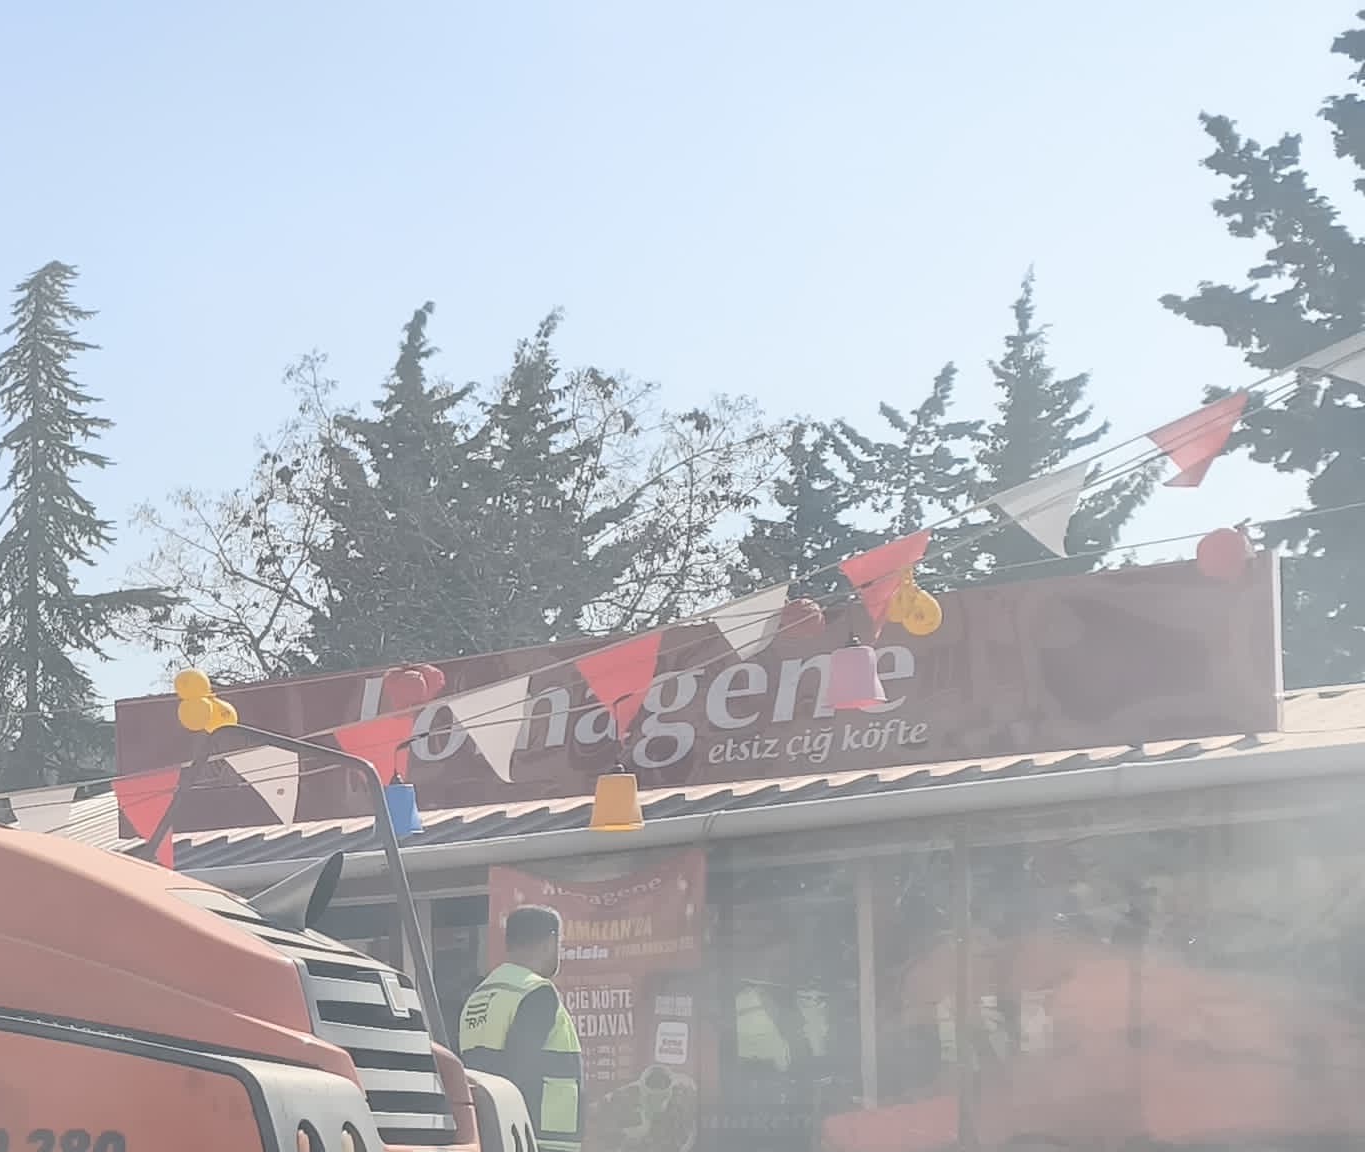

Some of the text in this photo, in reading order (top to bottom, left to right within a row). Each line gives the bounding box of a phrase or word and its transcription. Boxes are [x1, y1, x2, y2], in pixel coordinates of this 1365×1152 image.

[356, 643, 917, 770] omagene
[707, 718, 928, 765] etsiz çiğ köfte
